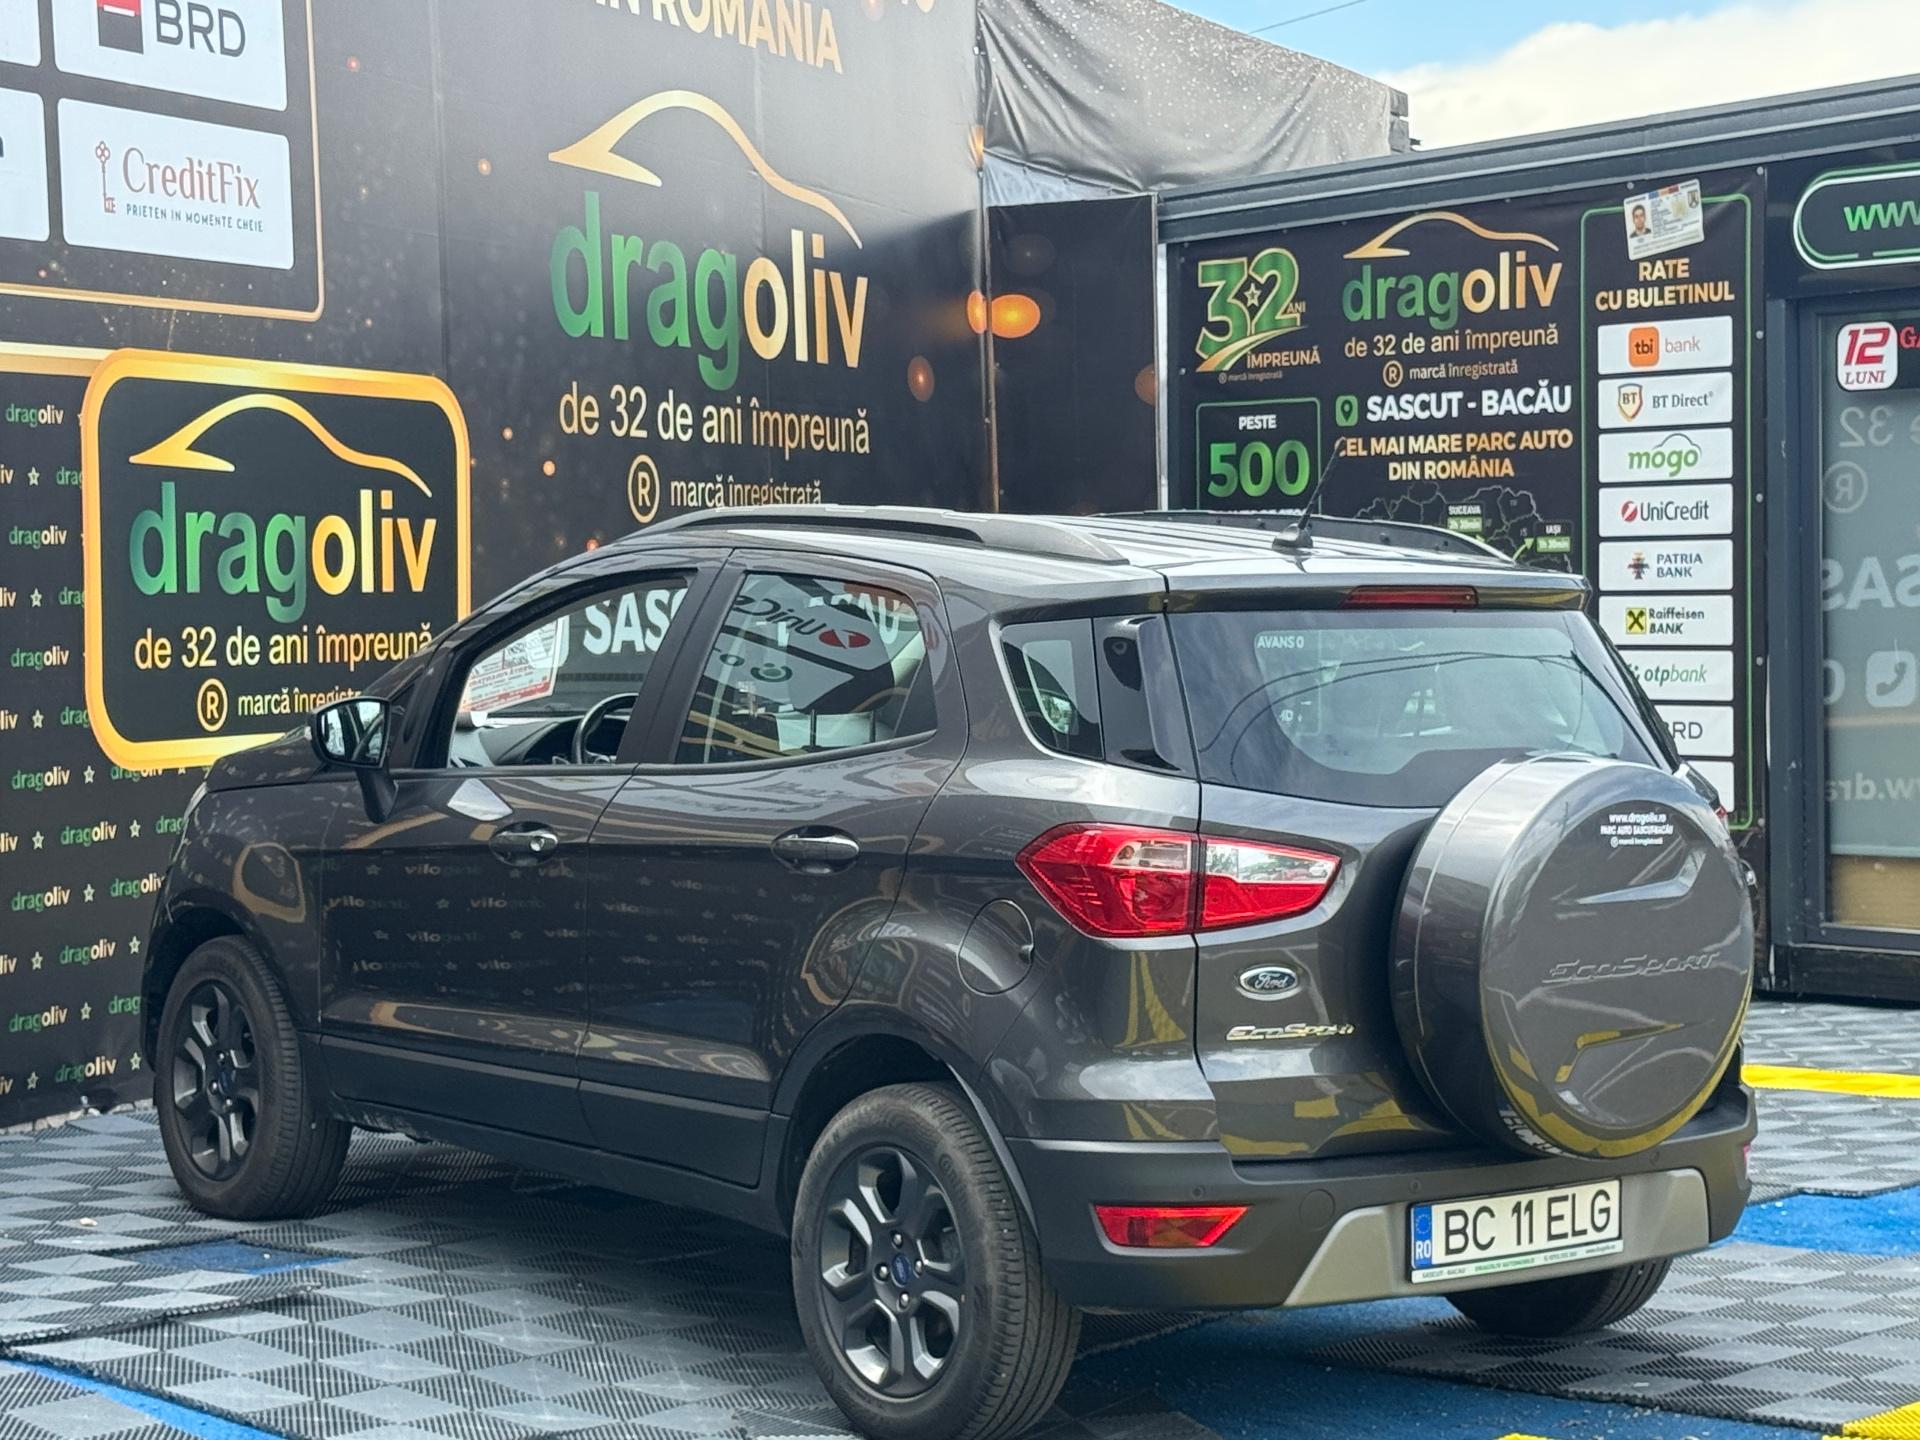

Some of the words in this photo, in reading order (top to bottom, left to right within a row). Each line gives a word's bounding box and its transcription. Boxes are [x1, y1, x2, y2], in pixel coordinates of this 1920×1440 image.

[156, 0, 246, 57] BRD
[123, 147, 261, 209] CreditFix
[126, 203, 167, 220] PRIETEN
[171, 209, 182, 221] IN
[186, 212, 233, 229] MOMENTE
[236, 217, 264, 233] CHEIE
[1639, 259, 1690, 281] RATE
[550, 190, 868, 391] dragoliv
[1342, 250, 1563, 331] dragoliv
[1595, 292, 1622, 311] CU
[1626, 281, 1735, 308] BULETINUL
[1195, 247, 1300, 361] 32
[1286, 301, 1306, 314] ANI
[1344, 337, 1368, 358] de
[1373, 334, 1397, 357] 32
[1401, 333, 1425, 354] de
[1430, 330, 1459, 352] ani
[1465, 323, 1559, 354] împreună
[1634, 339, 1653, 356] tbi
[1664, 335, 1701, 354] bank
[1843, 327, 1890, 366] 12
[1900, 327, 1920, 348] G
[1409, 363, 1446, 380] marcă
[1448, 359, 1519, 381] înregistrată
[1845, 370, 1886, 385] LUNI
[1366, 391, 1464, 423] SASCUT
[1481, 379, 1573, 416] BACĂU
[1652, 395, 1668, 409] BT
[6, 402, 64, 428] dragoliv
[559, 381, 600, 436] de
[609, 384, 649, 439] 32
[657, 388, 694, 442] de
[702, 395, 743, 445] ani
[749, 396, 871, 461] împreună
[1238, 414, 1277, 431] PESTE
[1370, 435, 1405, 456] MAI
[1408, 433, 1462, 453] MARE
[1465, 432, 1515, 452] PARC
[1519, 428, 1574, 450] AUTO
[1208, 440, 1310, 498] 500
[1388, 462, 1421, 481] DIN
[1424, 455, 1515, 480] ROMÂNIA
[1628, 449, 1699, 477] mogo
[670, 474, 725, 508] marcă
[1640, 501, 1709, 521] UniCredit
[9, 524, 67, 550] dragoliv
[129, 481, 437, 623] dragoliv
[1656, 554, 1703, 564] PATRIA
[1656, 567, 1693, 577] BANK
[1648, 608, 1705, 620] Raiffeisen
[1649, 623, 1684, 634] BANK
[134, 627, 173, 670] de
[181, 626, 217, 668] 32
[226, 626, 262, 666] de
[269, 626, 309, 665] ani
[1257, 636, 1295, 648] AVANS
[11, 645, 69, 671] dragoliv
[1644, 664, 1708, 687] otpbank
[238, 687, 291, 716] marcă
[12, 766, 71, 792] dragoliv
[61, 821, 117, 847] dragoliv
[12, 886, 71, 912] dragoliv
[60, 939, 116, 966] dragoliv
[1255, 973, 1287, 988] Ford
[9, 1006, 68, 1033] dragoliv
[1226, 1023, 1355, 1041] EcoSport
[1445, 1205, 1496, 1256] BC
[1512, 1200, 1533, 1246] 11
[1547, 1189, 1611, 1242] ELG
[1416, 1241, 1431, 1260] RO
